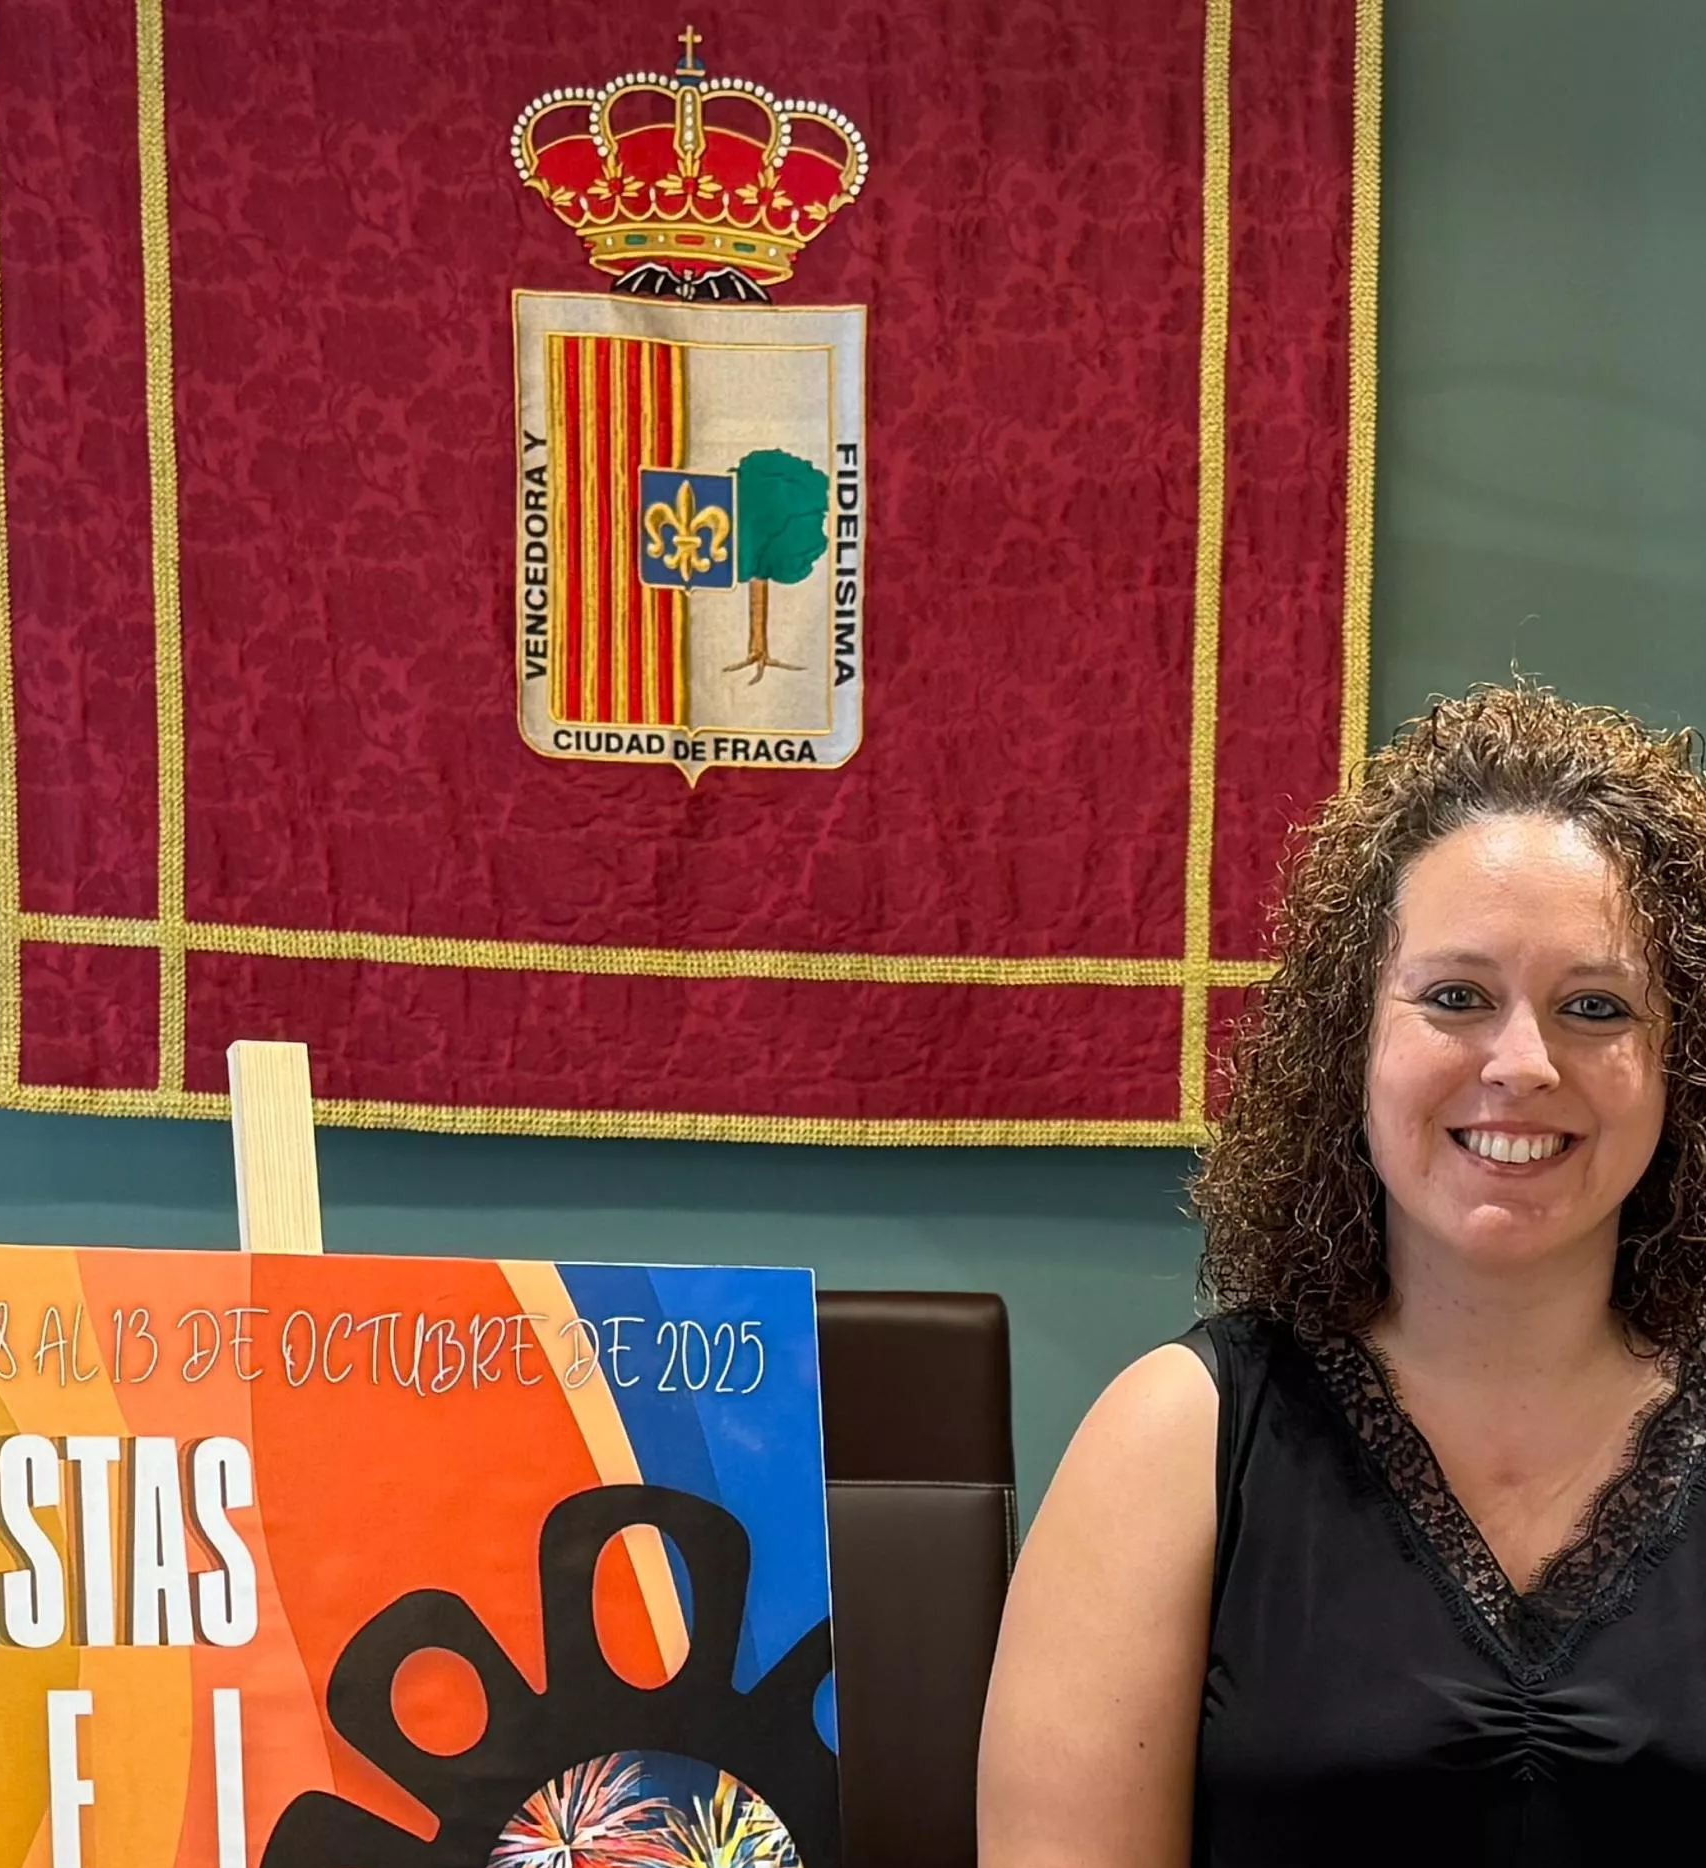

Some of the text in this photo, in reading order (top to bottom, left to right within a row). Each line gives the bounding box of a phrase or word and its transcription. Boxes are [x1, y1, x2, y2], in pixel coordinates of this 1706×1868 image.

[523, 429, 548, 681] VENCEDORA Y
[833, 443, 858, 688] FIDELISIMA
[553, 729, 817, 763] CIUDAD DE FRAGA
[33, 1303, 100, 1387] AL
[112, 1307, 159, 1384] 13
[176, 1308, 270, 1383] DE
[280, 1309, 549, 1397] OCTUBRE
[557, 1315, 646, 1390] DE
[655, 1319, 765, 1395] 2025
